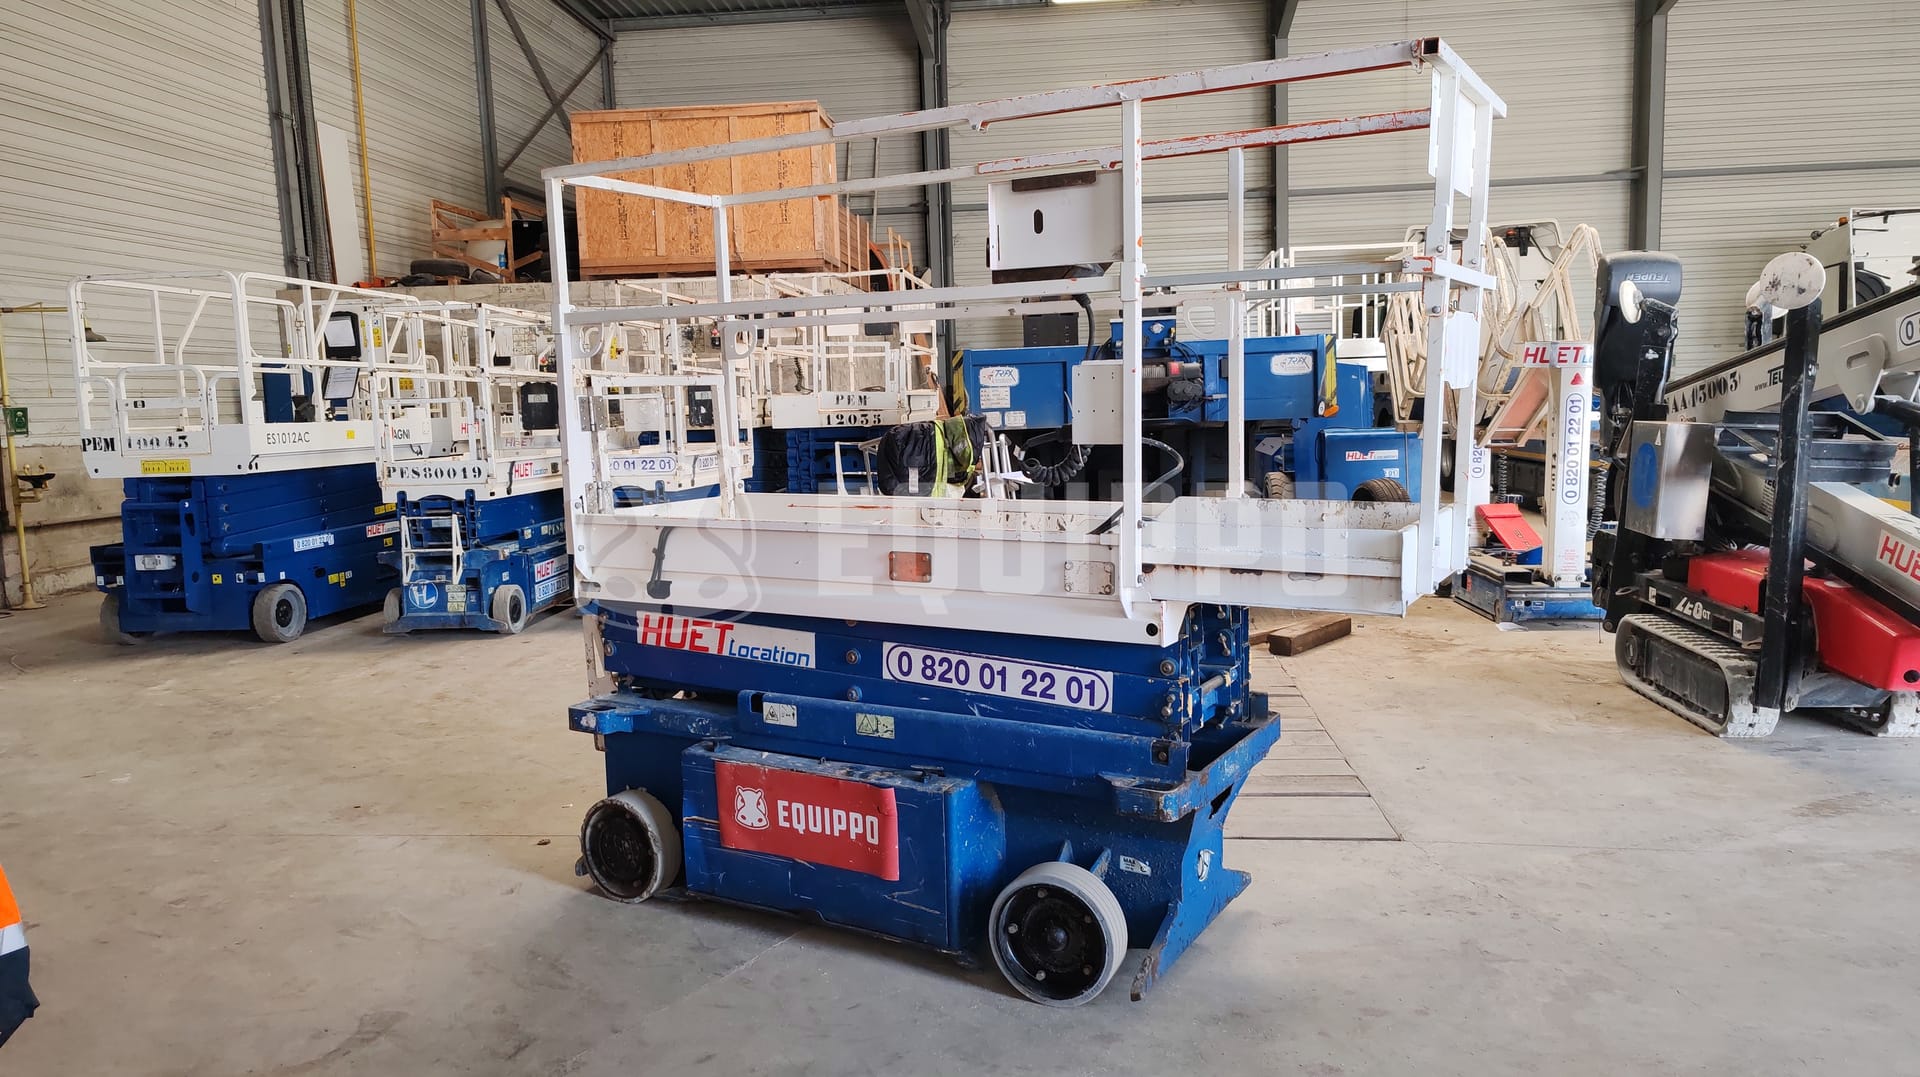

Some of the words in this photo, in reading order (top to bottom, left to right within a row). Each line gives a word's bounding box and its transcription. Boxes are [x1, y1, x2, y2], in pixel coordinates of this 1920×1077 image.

[835, 395, 867, 406] PEM
[1570, 399, 1582, 413] 01
[1568, 418, 1581, 434] 22
[81, 436, 116, 452] PEM
[266, 431, 311, 445] ES1012AC
[1567, 445, 1580, 459] 01
[386, 466, 482, 479] PES80019
[514, 462, 533, 478] HUET
[624, 460, 636, 470] 01
[641, 459, 656, 470] 22
[660, 459, 671, 470] 01
[1565, 461, 1579, 486] 820
[368, 524, 385, 535] HUET
[536, 560, 555, 579] HUET
[642, 613, 735, 655] HUET
[728, 638, 810, 667] Location
[897, 650, 913, 677] 0
[921, 654, 970, 686] 820
[979, 662, 1008, 692] 01
[1021, 669, 1056, 701] 22
[1066, 676, 1096, 708] 01
[777, 799, 879, 846] EQUIPPO
